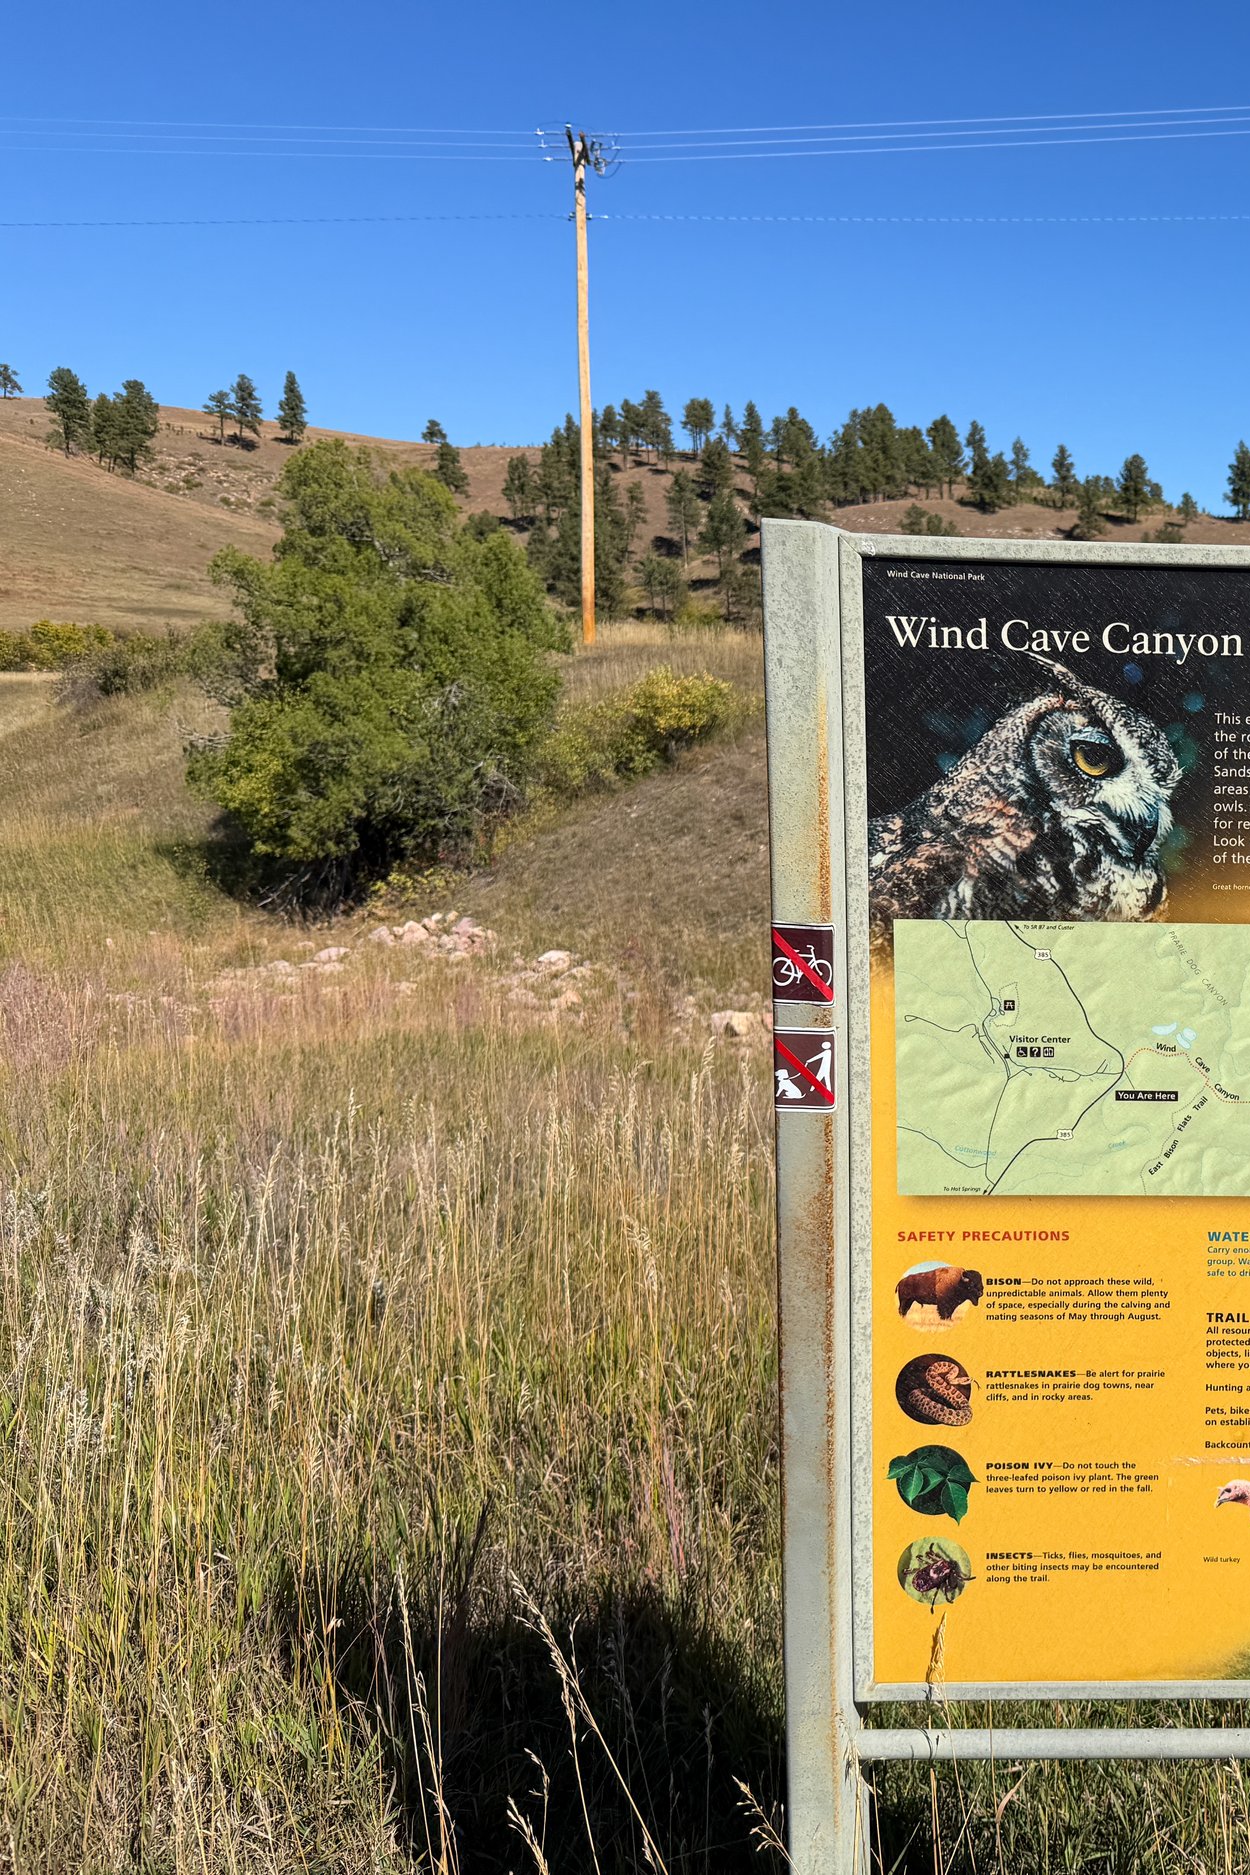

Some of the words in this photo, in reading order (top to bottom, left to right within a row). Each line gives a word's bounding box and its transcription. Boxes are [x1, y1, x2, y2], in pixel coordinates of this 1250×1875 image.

[910, 571, 930, 579] Cave
[932, 572, 966, 580] National
[886, 616, 989, 650] Wind
[1000, 620, 1090, 653] Cave
[1102, 622, 1244, 665] Canyon
[1214, 712, 1241, 725] This
[1214, 730, 1236, 742] the
[1214, 747, 1228, 760] of
[1213, 816, 1233, 829] for
[1169, 931, 1187, 955] PRARIE
[1186, 959, 1201, 975] DOG
[1202, 978, 1228, 1006] CANYON
[1009, 1035, 1038, 1043] Visitor
[1041, 1035, 1071, 1043] Center
[1156, 1042, 1176, 1053] Wind
[1195, 1056, 1211, 1073] Cave
[1214, 1083, 1240, 1100] Canyon
[1148, 1161, 1163, 1176] East
[1164, 1139, 1179, 1159] Bison
[1177, 1114, 1192, 1132] Flats
[1192, 1096, 1208, 1111] Trail
[898, 1231, 955, 1242] SAFETY
[962, 1231, 1070, 1241] PRECAUTIONS
[1207, 1246, 1230, 1256] Carry
[1064, 1278, 1104, 1287] approach
[1107, 1277, 1130, 1285] these
[1133, 1278, 1154, 1286] wild,
[986, 1289, 1046, 1298] unpredictable
[1141, 1289, 1168, 1299] plenty
[1206, 1312, 1249, 1323] TRAIL
[1137, 1370, 1165, 1379] prairie
[1068, 1551, 1088, 1560] flies,
[1091, 1551, 1143, 1560] mosquitoes,
[986, 1575, 1010, 1584] along
